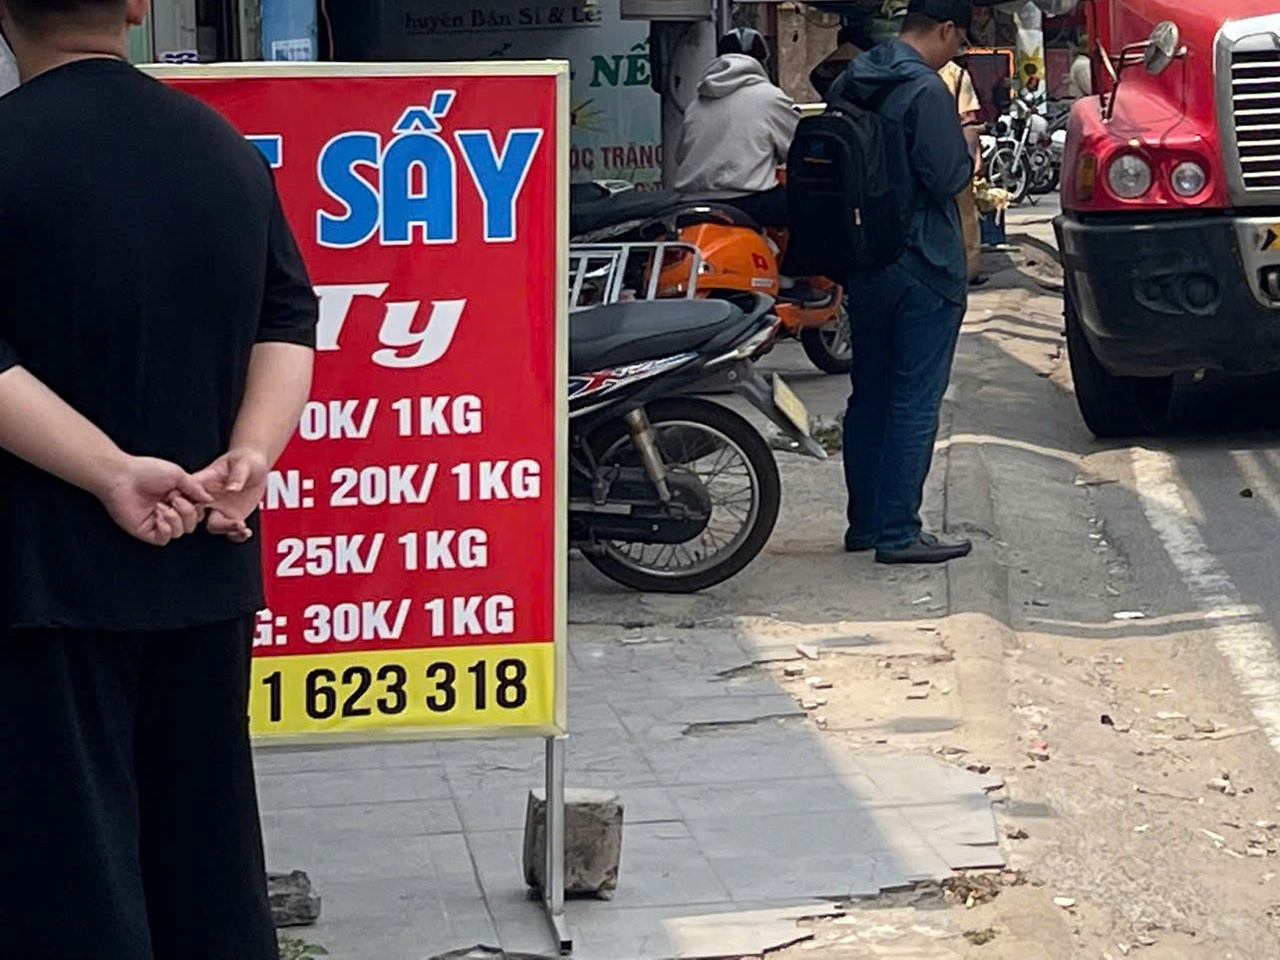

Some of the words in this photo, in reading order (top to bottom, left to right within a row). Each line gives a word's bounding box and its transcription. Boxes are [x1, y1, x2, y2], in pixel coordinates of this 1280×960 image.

[590, 40, 651, 87] NẾ
[317, 90, 543, 249] SẤY
[313, 283, 467, 368] Ty
[299, 398, 379, 440] 0K/
[392, 395, 482, 436] 1KG
[259, 469, 314, 510] N:
[330, 463, 437, 507] 20K/
[451, 460, 541, 501] 1KG
[275, 533, 385, 577] 25K/
[399, 529, 488, 571] 1KG
[252, 608, 287, 647] G:
[303, 599, 411, 644] 30K/
[424, 595, 515, 637] 1KG
[305, 664, 407, 720] 623
[426, 658, 527, 712] 318
